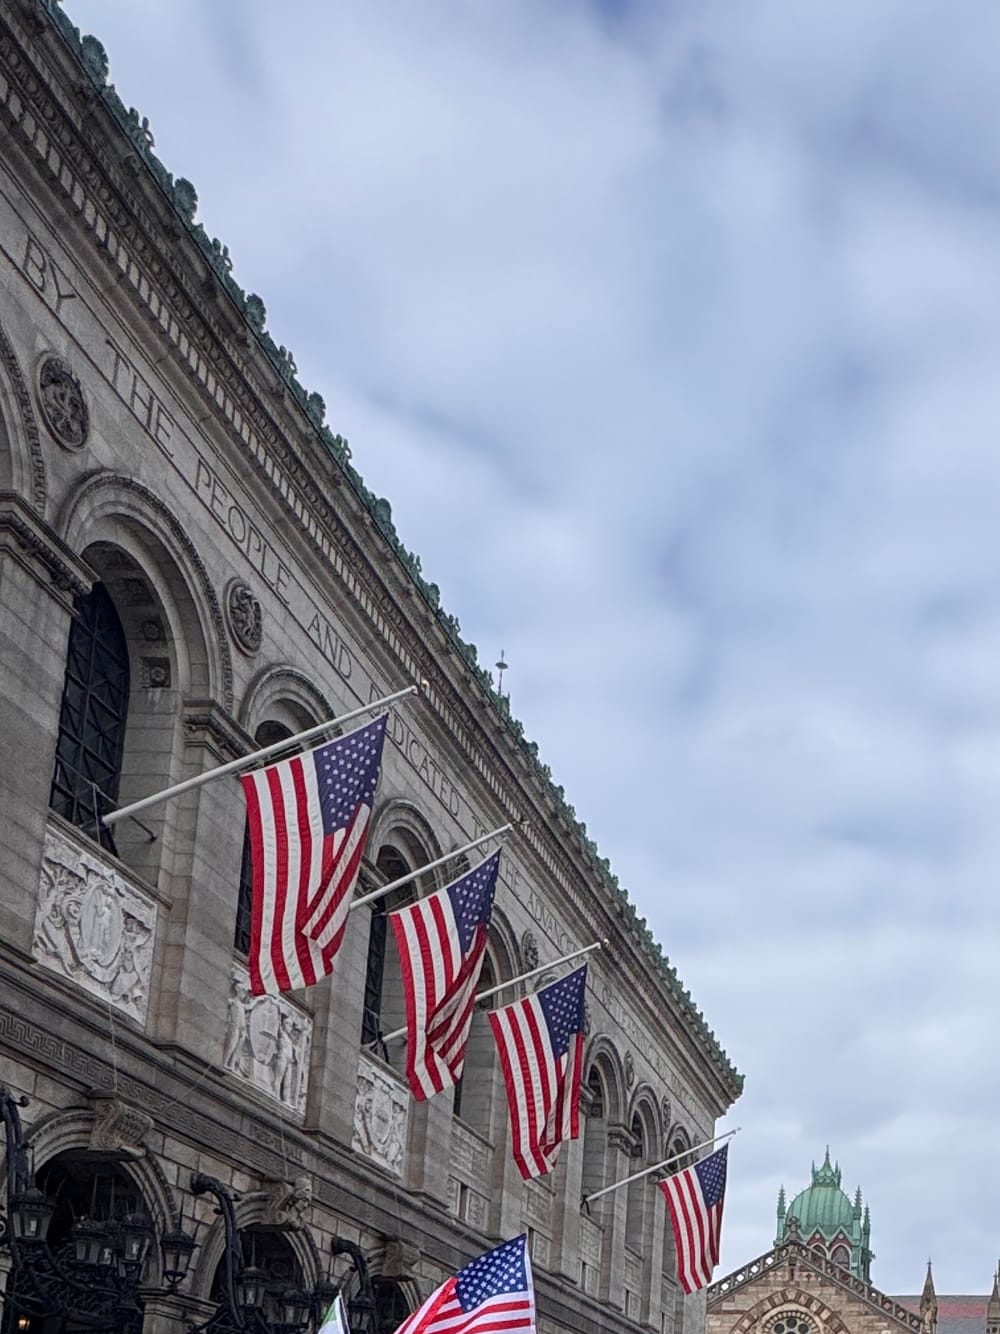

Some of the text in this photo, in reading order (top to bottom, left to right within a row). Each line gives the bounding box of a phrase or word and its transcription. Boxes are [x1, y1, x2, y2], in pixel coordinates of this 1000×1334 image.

[22, 233, 77, 315] BY
[104, 338, 176, 459] THE
[194, 457, 293, 605] PEOPLE
[307, 612, 353, 679] AND
